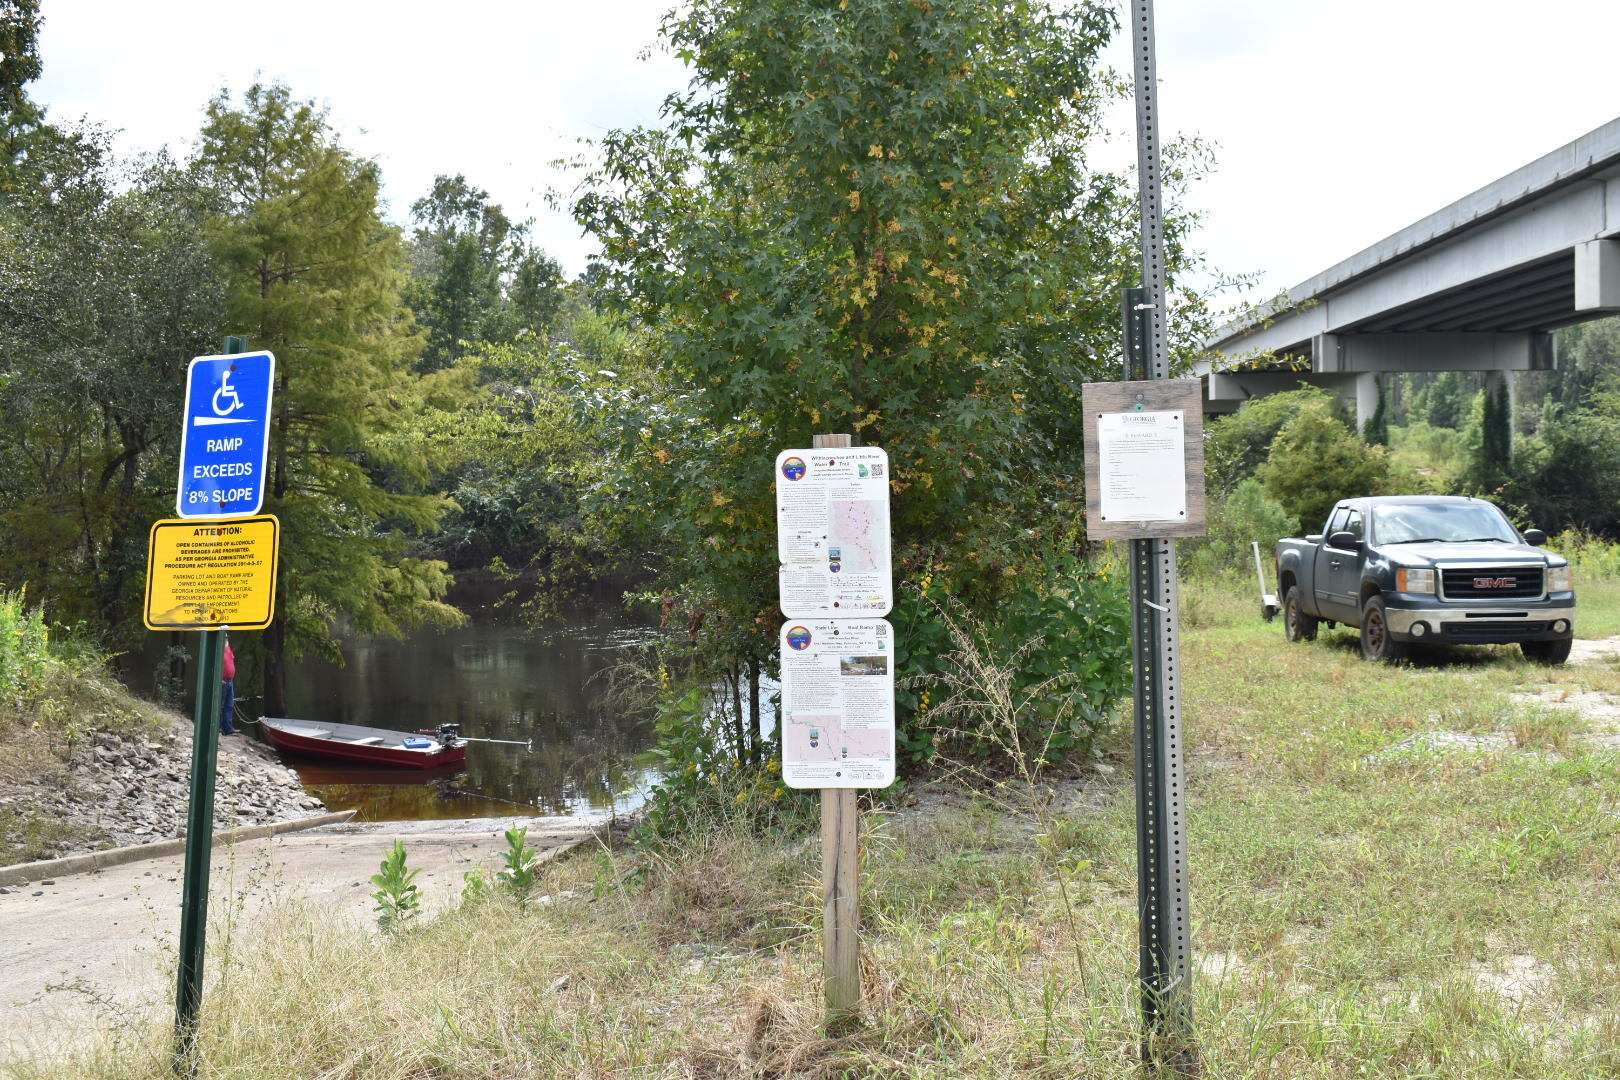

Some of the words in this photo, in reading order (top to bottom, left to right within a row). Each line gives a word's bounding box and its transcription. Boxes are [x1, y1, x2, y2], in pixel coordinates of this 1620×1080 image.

[207, 438, 243, 452] RAMP
[193, 462, 253, 478] EXCEEDS
[189, 490, 209, 504] 8%
[212, 487, 253, 502] SLOPE
[1473, 577, 1517, 589] GMC
